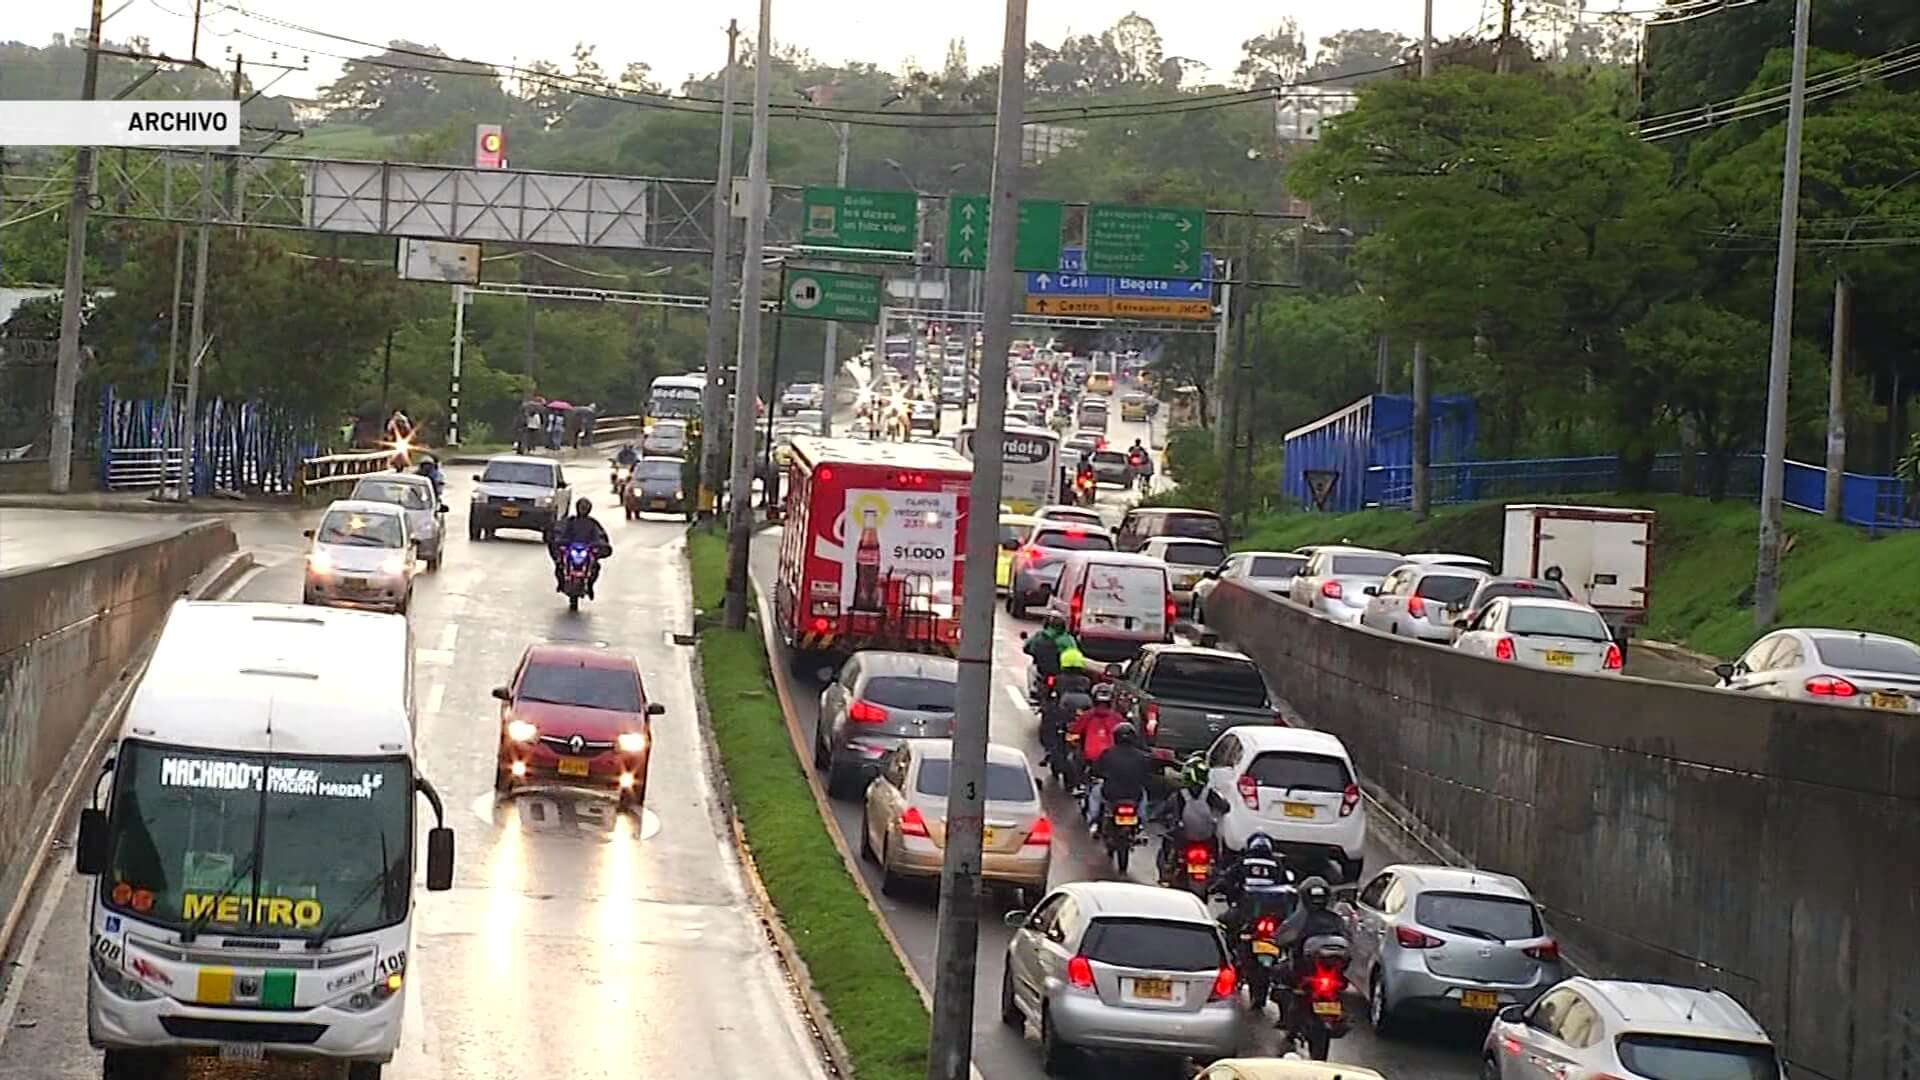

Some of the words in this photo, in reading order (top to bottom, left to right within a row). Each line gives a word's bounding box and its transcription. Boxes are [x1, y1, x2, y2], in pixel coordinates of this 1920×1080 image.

[1059, 275, 1089, 289] Cali
[893, 545, 945, 560] $1.000
[161, 758, 250, 790] MACHADO
[183, 893, 322, 929] METRO
[93, 934, 122, 961] 108
